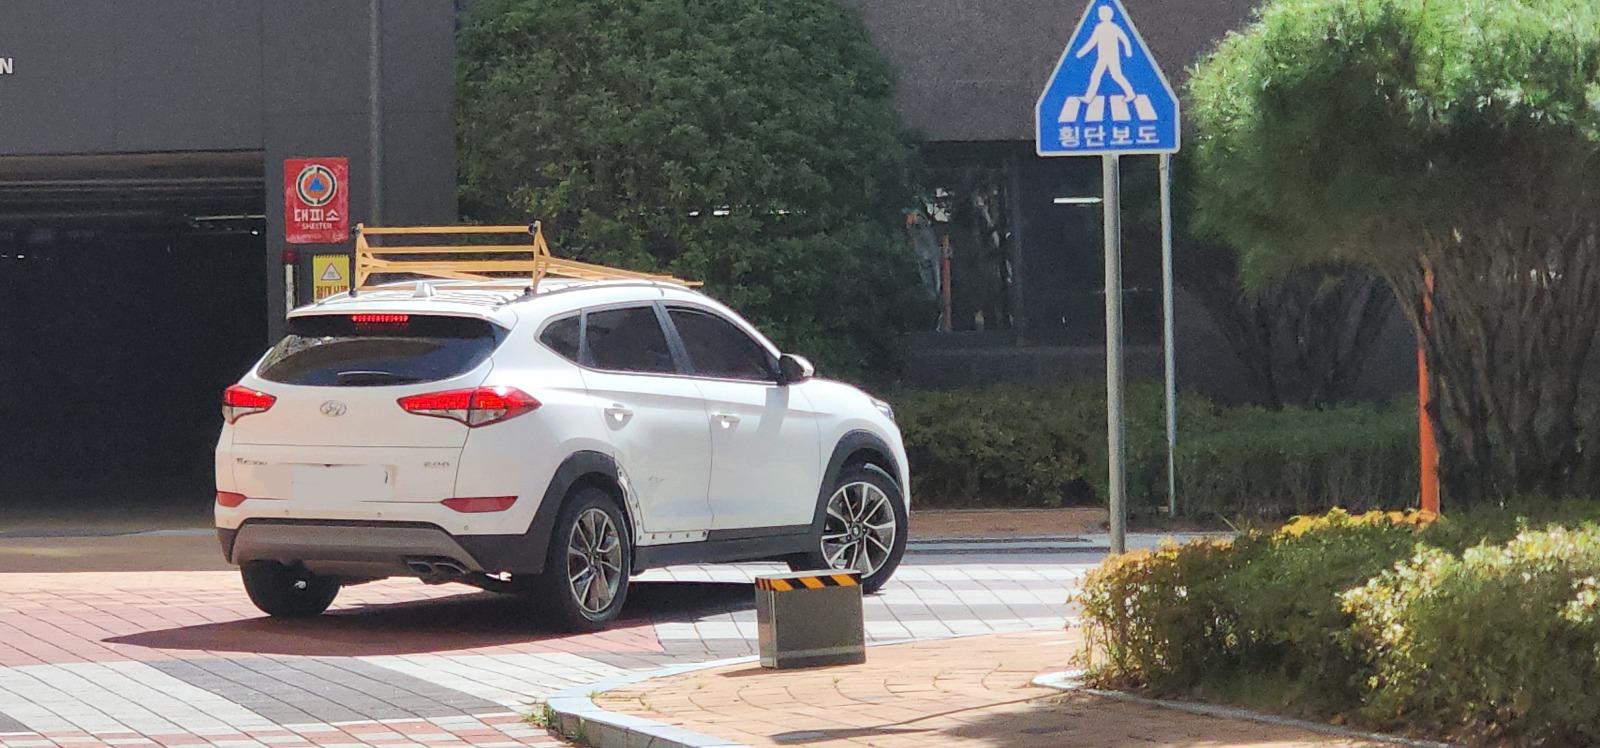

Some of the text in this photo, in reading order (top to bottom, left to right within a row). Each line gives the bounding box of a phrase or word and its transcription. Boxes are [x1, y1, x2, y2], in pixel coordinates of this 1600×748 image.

[1058, 125, 1160, 147] 횡단보도
[294, 208, 341, 222] 대피소
[301, 222, 332, 230] SHELTER
